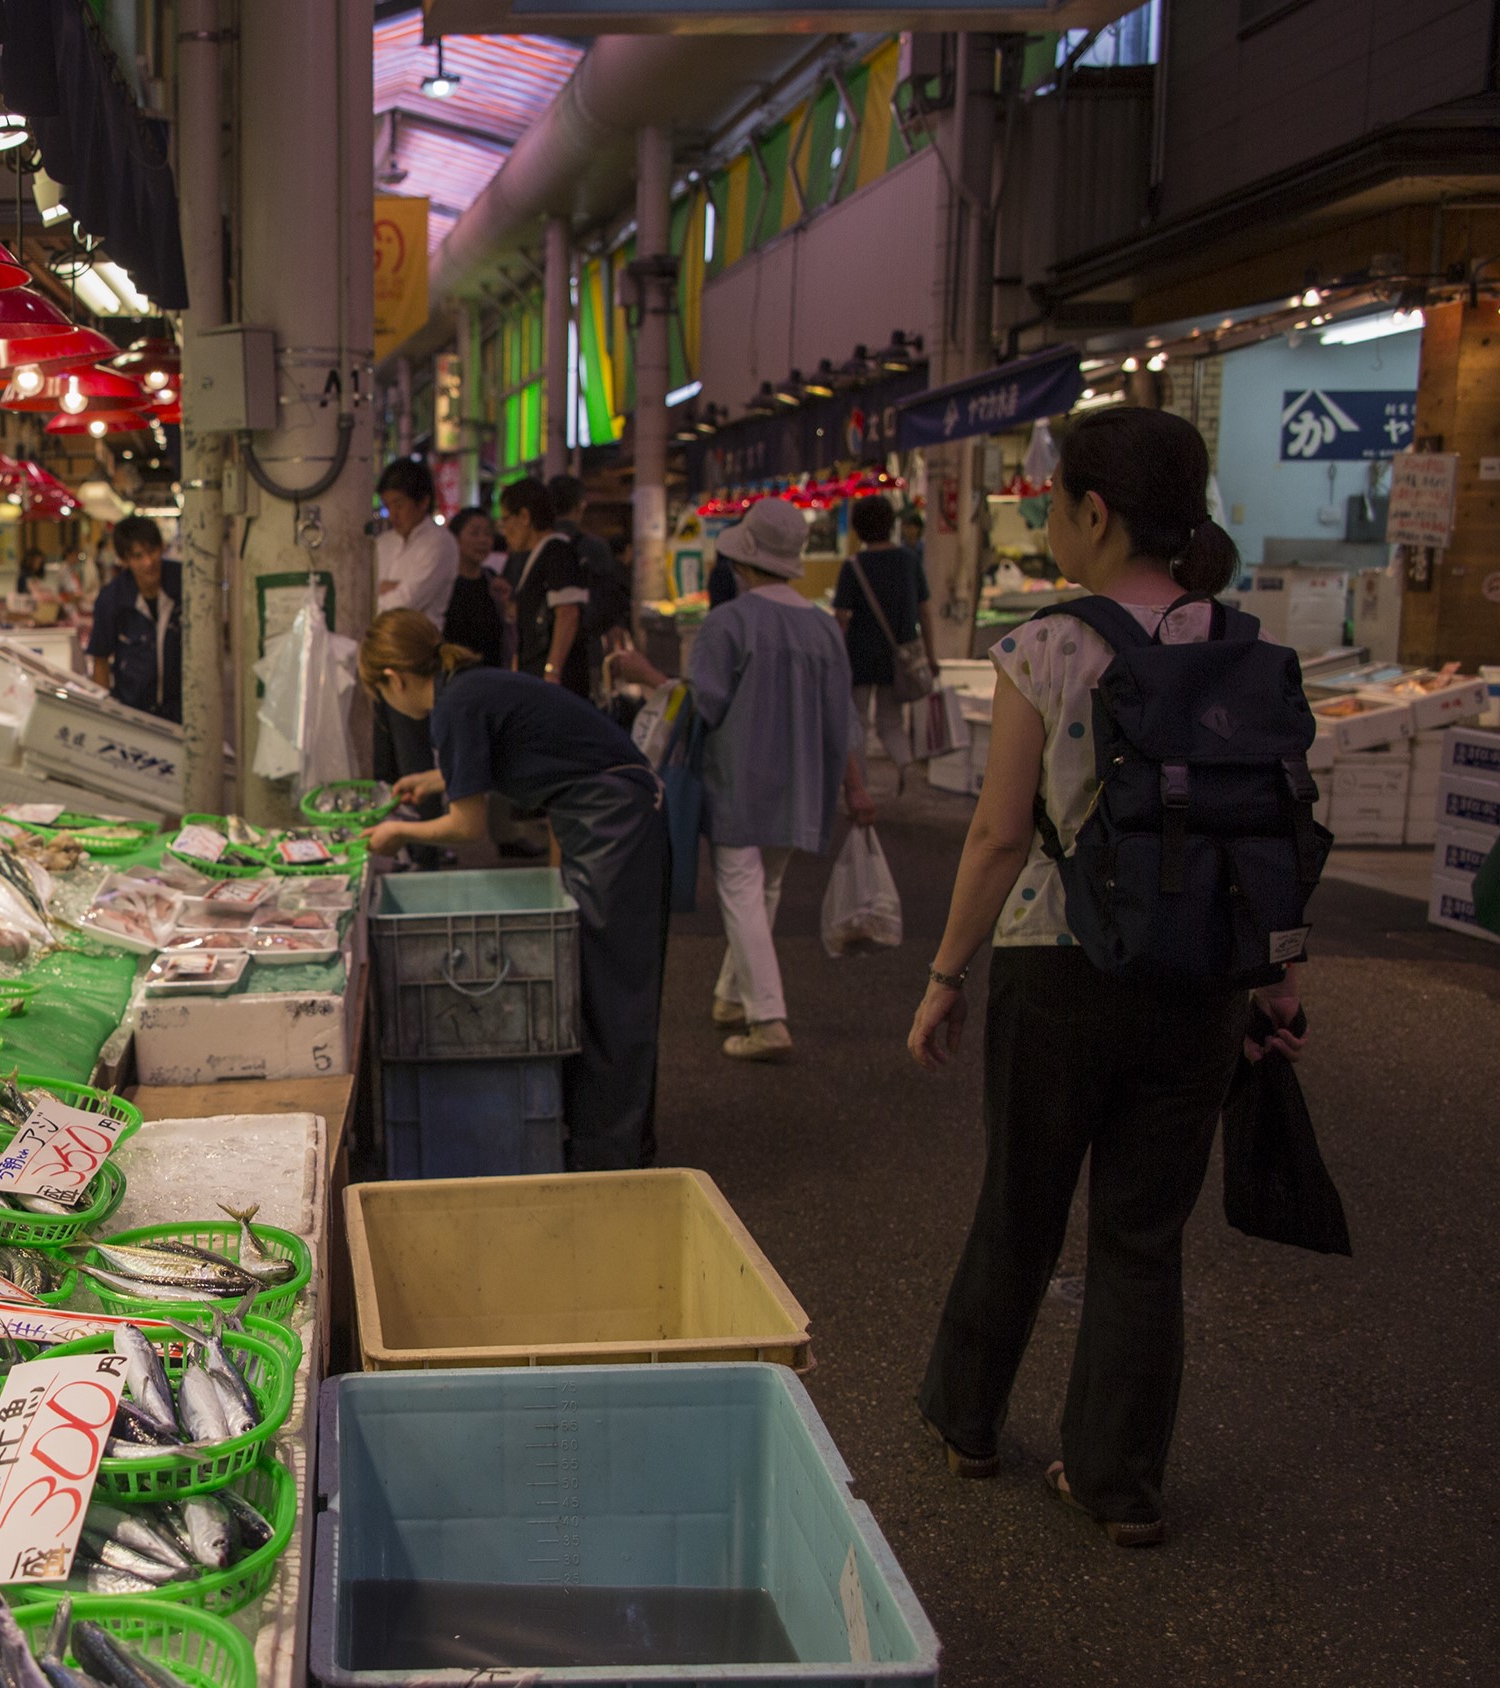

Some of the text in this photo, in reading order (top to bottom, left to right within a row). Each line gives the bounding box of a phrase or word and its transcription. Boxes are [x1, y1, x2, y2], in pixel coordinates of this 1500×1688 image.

[312, 1043, 333, 1072] 5
[561, 1381, 578, 1393] 75
[561, 1400, 579, 1413] 70
[560, 1419, 579, 1432] 65
[561, 1439, 579, 1451] 60
[561, 1458, 580, 1470] 55
[561, 1477, 580, 1489] 50
[562, 1496, 580, 1509] 45
[562, 1515, 580, 1528] 40
[563, 1534, 580, 1546] 35
[563, 1553, 581, 1566] 30
[563, 1573, 581, 1585] 25
